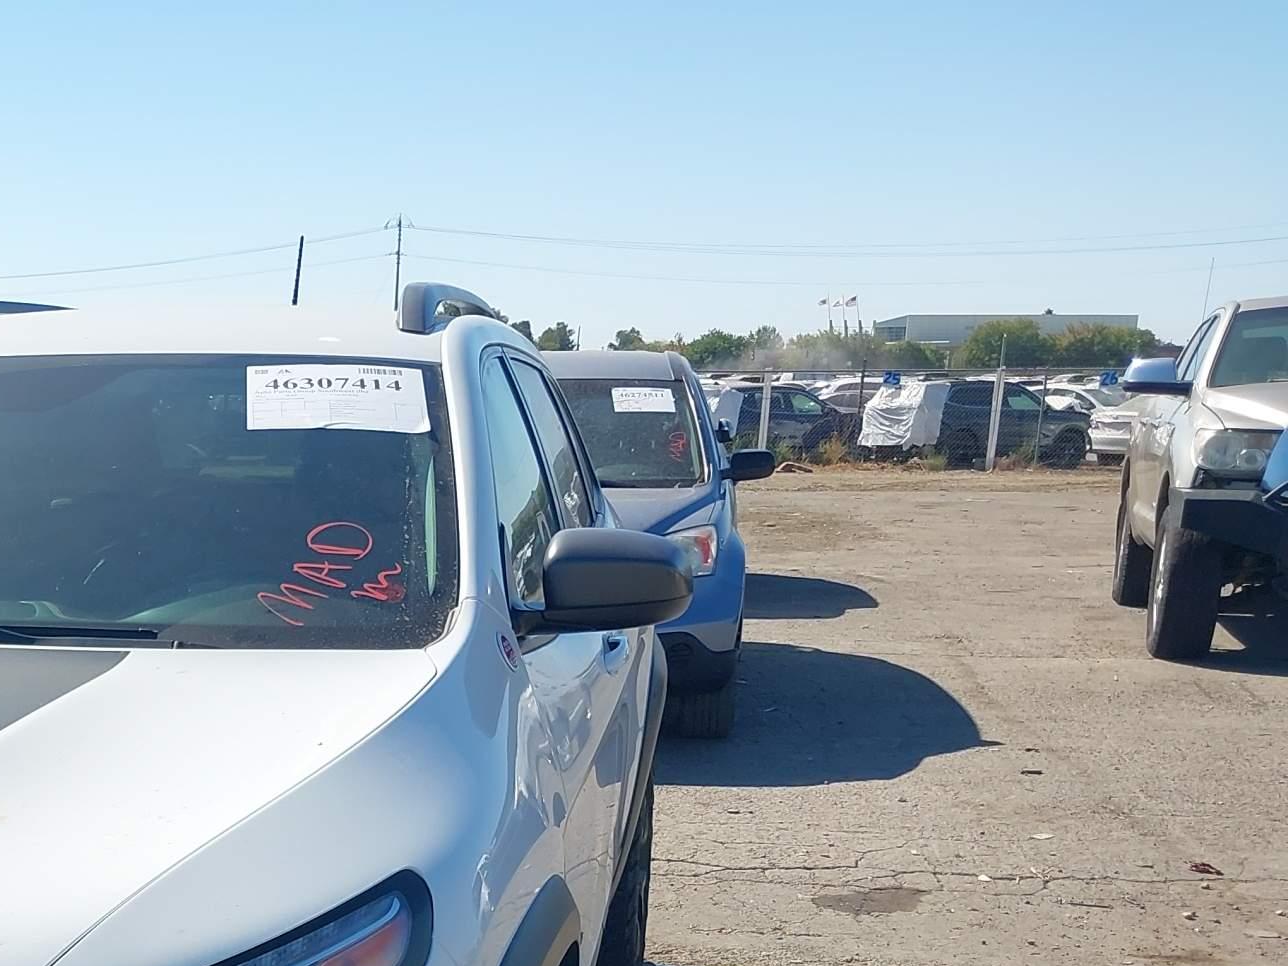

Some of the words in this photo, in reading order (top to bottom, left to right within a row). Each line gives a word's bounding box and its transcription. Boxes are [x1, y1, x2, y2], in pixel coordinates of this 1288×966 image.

[264, 377, 402, 392] 46307414
[883, 371, 901, 385] 25
[1101, 371, 1119, 386] 26
[257, 521, 373, 626] MAD
